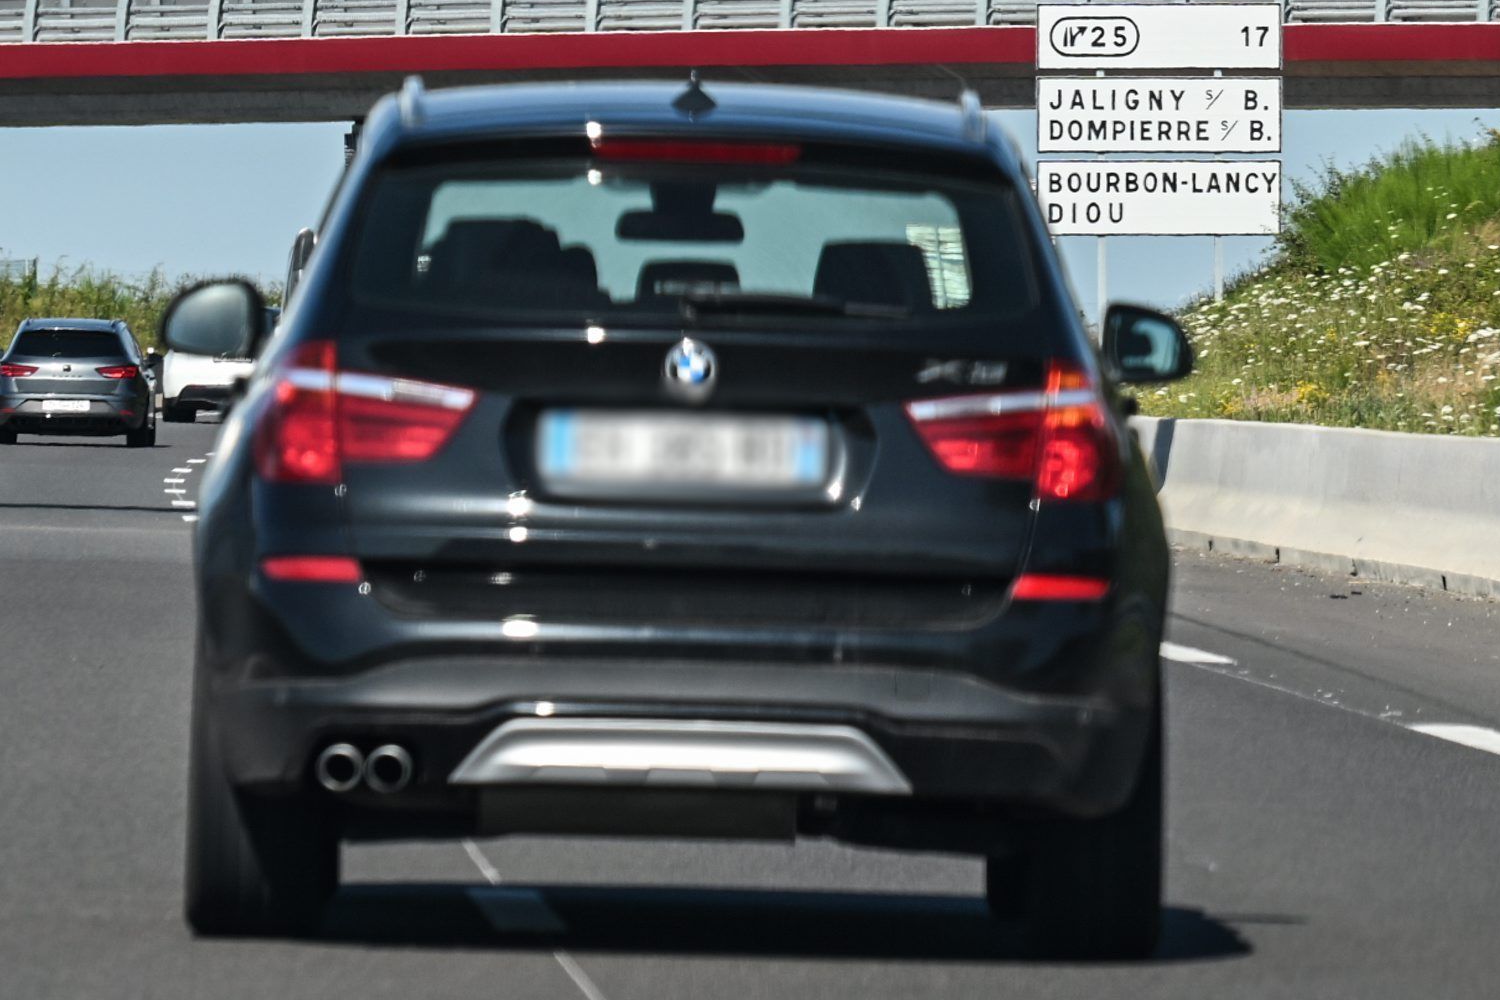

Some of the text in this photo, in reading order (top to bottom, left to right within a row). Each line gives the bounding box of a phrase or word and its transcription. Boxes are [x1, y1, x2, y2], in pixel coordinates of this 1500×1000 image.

[1091, 26, 1127, 47] 25
[1241, 26, 1269, 47] 17
[1050, 89, 1185, 110] JALIGNY
[1244, 89, 1269, 110] B.
[1050, 120, 1209, 141] DOMPIERRE
[1250, 120, 1272, 141] B.
[1049, 172, 1276, 193] BOURBON-LANCY
[1048, 203, 1123, 224] DIOU
